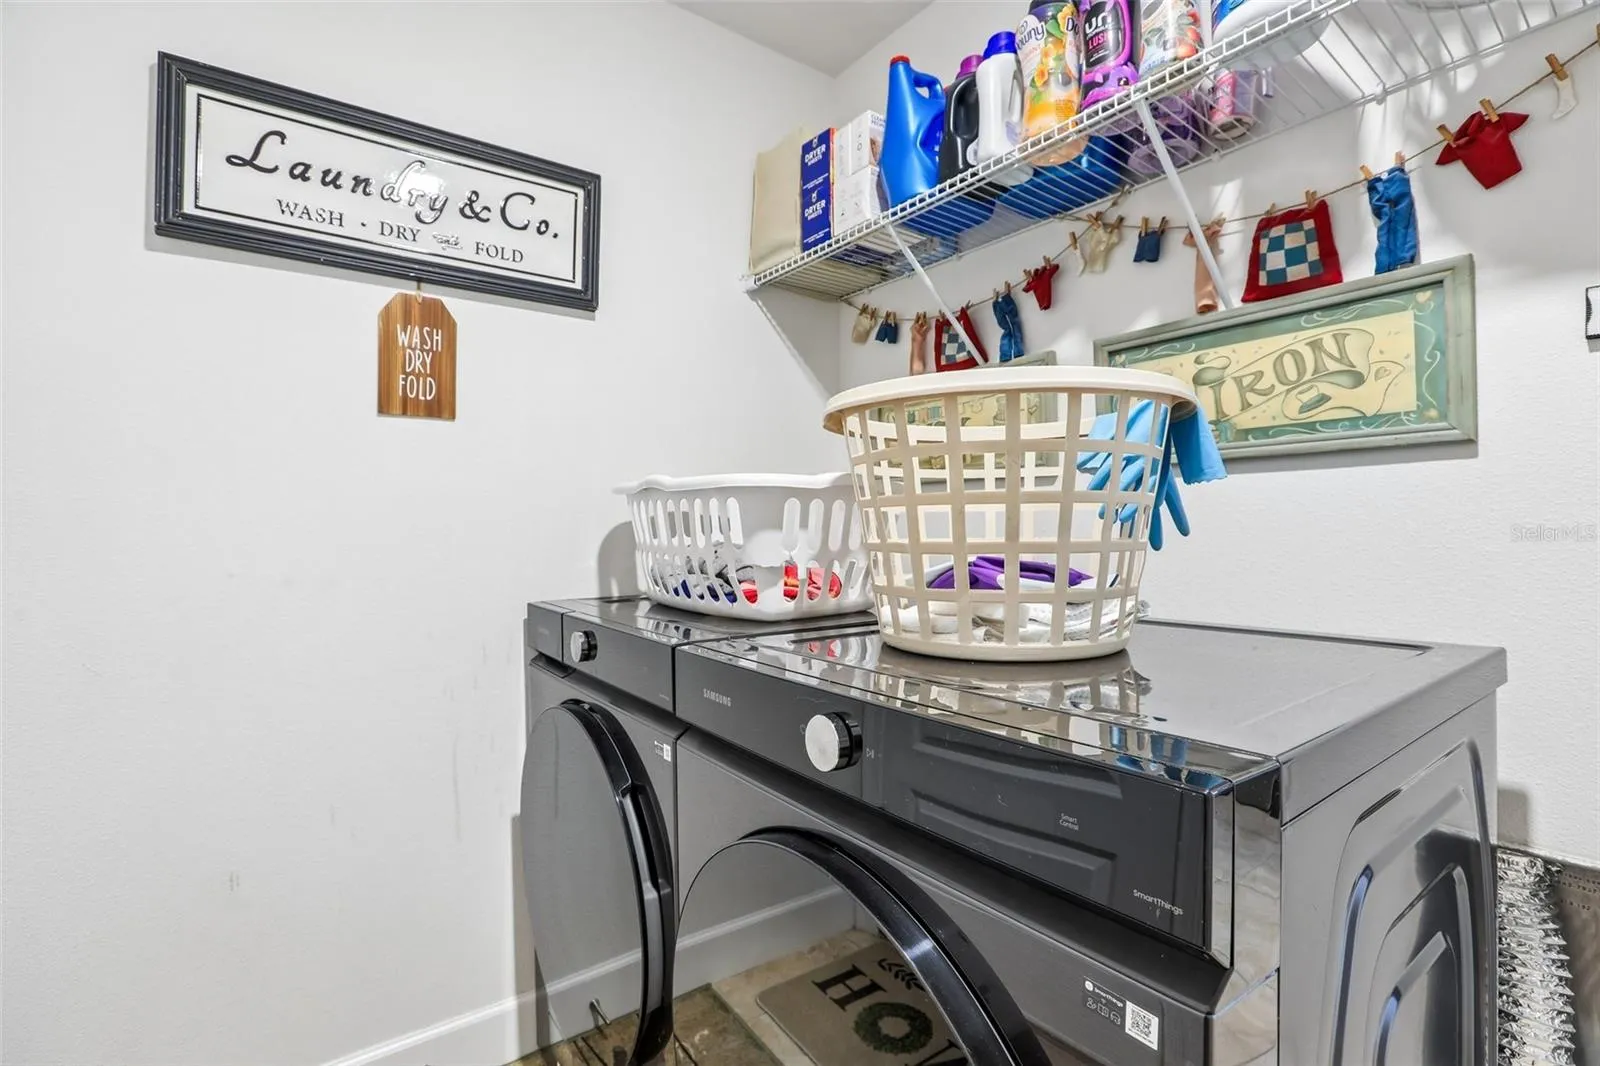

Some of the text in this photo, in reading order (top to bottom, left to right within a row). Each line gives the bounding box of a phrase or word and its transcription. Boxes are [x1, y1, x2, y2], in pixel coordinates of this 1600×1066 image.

[1016, 23, 1045, 50] owny
[804, 143, 826, 164] DRYER
[225, 130, 448, 225] Laundry
[804, 199, 826, 218] DRYER
[276, 199, 345, 227] WASH
[379, 220, 421, 242] DRY
[474, 241, 524, 263] FOLD
[396, 323, 442, 352] WASH
[405, 349, 433, 374] DRY
[398, 375, 436, 400] FOLD
[1208, 332, 1357, 422] IRON
[703, 688, 732, 707] SAMSUNG
[1060, 813, 1078, 823] Smart
[1132, 888, 1184, 915] SmartThings
